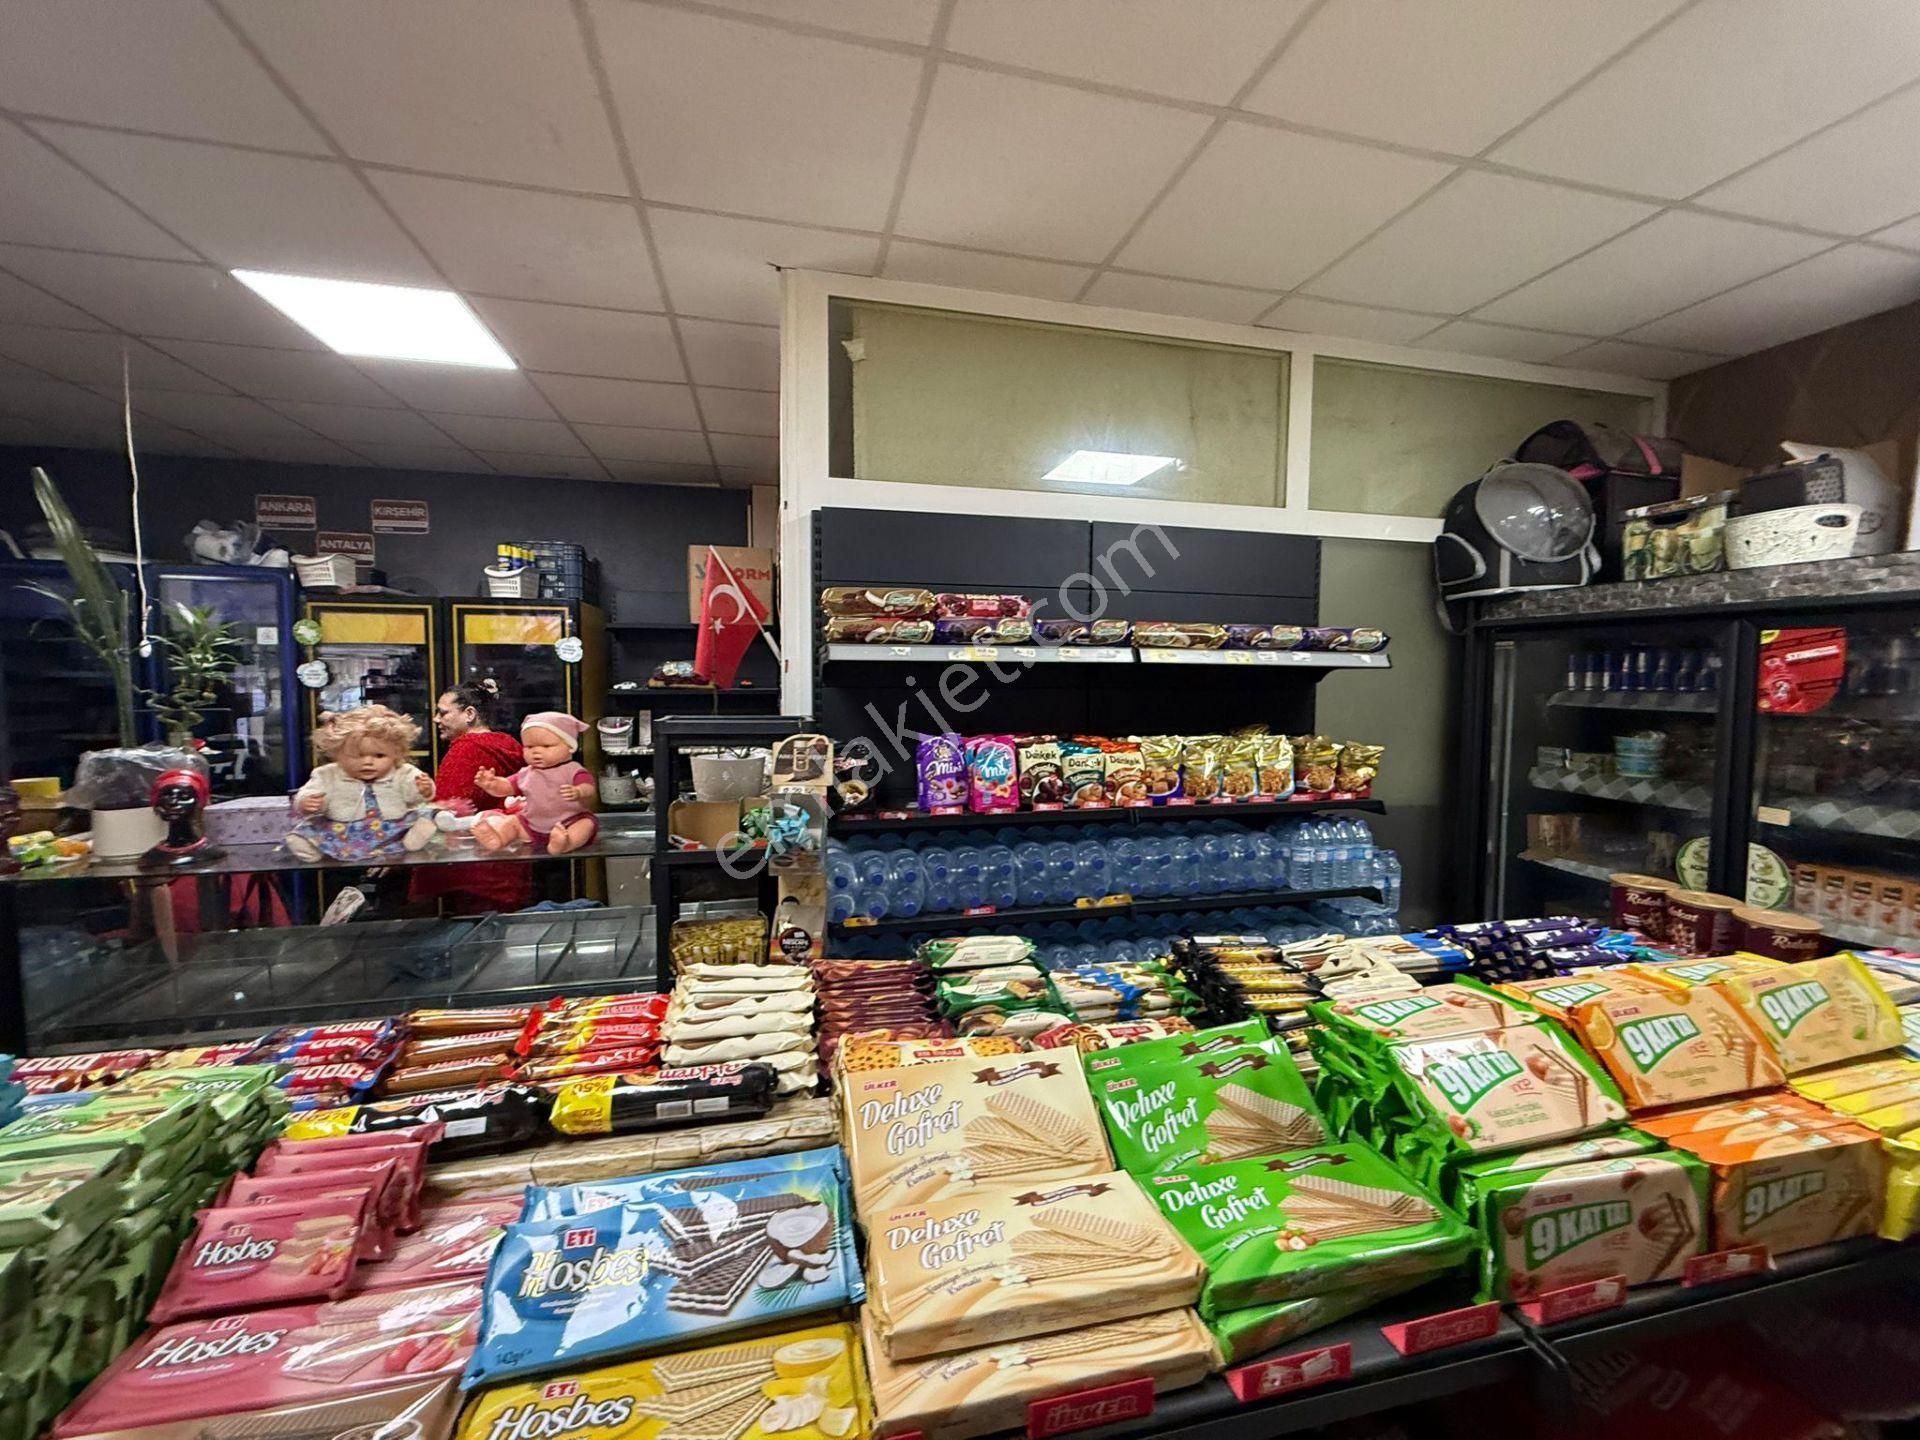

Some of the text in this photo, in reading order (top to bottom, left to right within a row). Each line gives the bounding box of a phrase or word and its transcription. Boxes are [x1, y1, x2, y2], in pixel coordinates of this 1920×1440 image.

[259, 501, 313, 513] ANKARA
[319, 539, 373, 551] ANTALYA
[859, 1083, 943, 1131] Deluxe
[887, 1100, 964, 1156] Gofret
[1141, 1097, 1199, 1153] Gofret
[1158, 1174, 1239, 1212] Deluxe
[1200, 1186, 1272, 1230] Gofret
[885, 1207, 981, 1251] Deluxe
[919, 1220, 1006, 1270] Gofret
